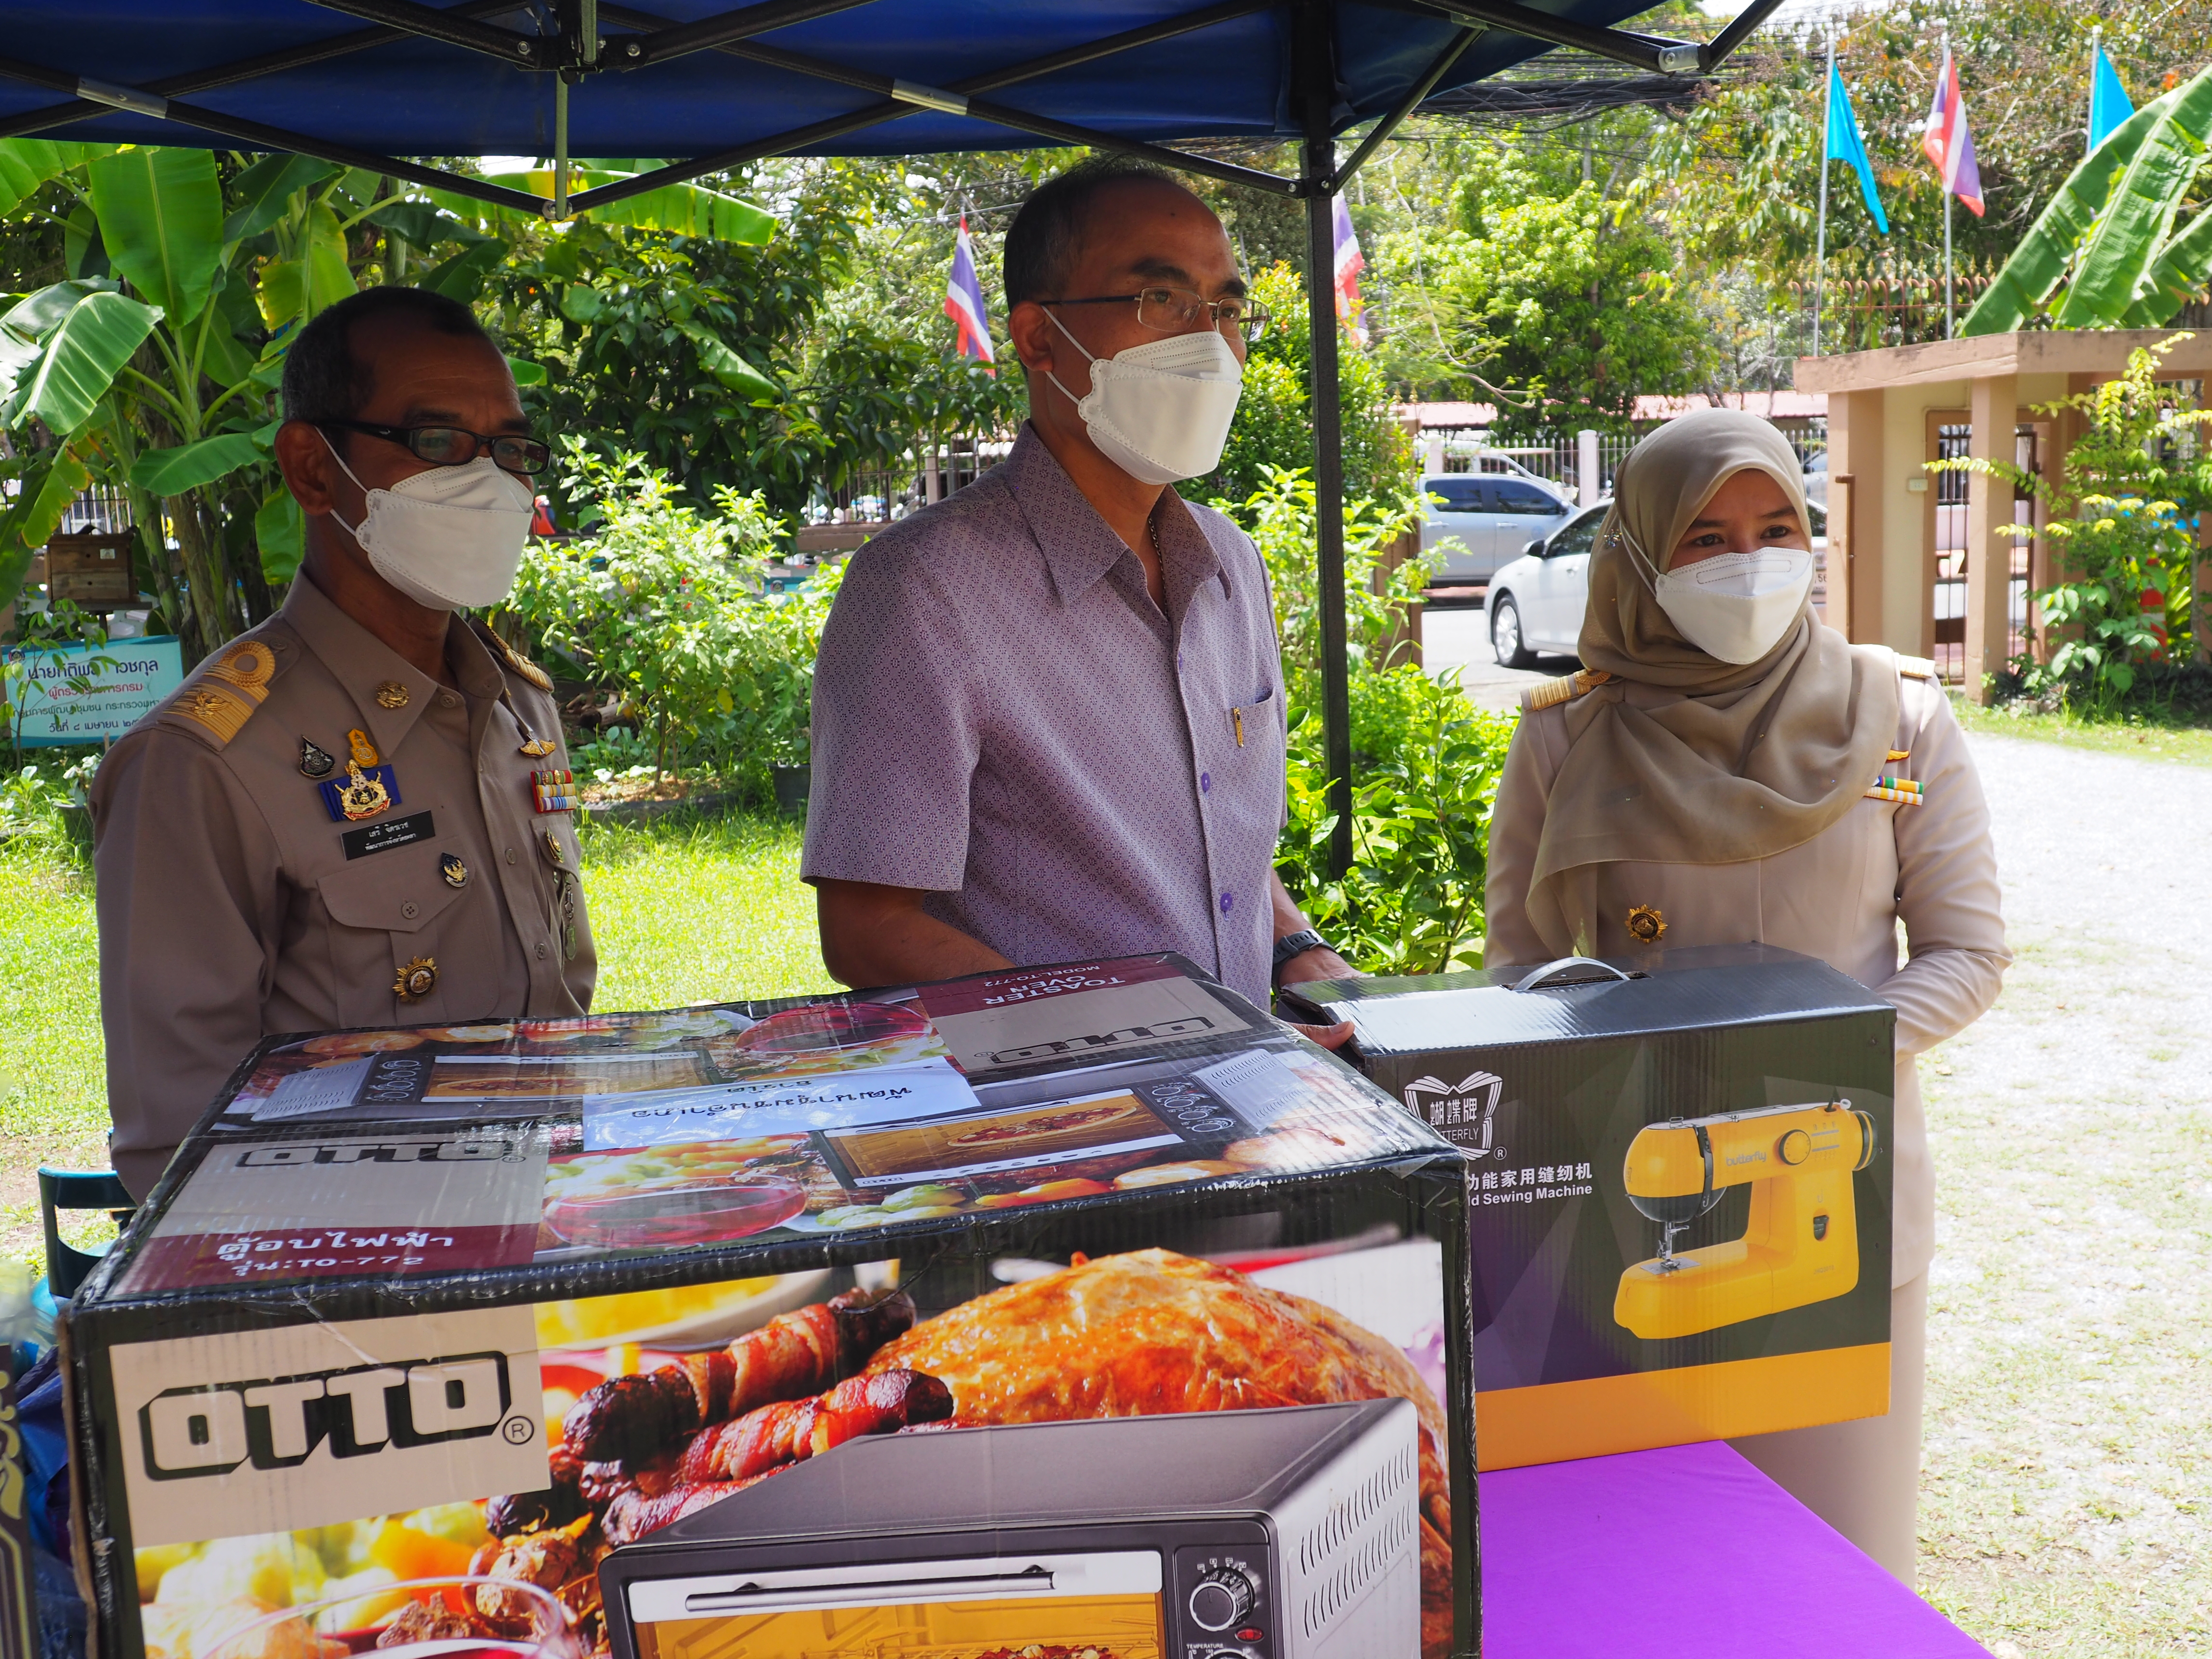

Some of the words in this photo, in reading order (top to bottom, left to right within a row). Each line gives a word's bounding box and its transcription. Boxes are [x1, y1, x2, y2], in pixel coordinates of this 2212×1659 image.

[982, 976, 1126, 1005] TOASTER
[1010, 975, 1087, 993] OVEN
[1430, 1098, 1478, 1126] 蝴蝶牌
[234, 1140, 514, 1167] OTTO
[1726, 1151, 1767, 1166] butterfly
[1483, 1190, 1532, 1204] Sewing
[1536, 1184, 1593, 1199] Machine
[216, 1231, 454, 1261] ตู้อบไฟฟ้า
[137, 1350, 513, 1482] OTTO
